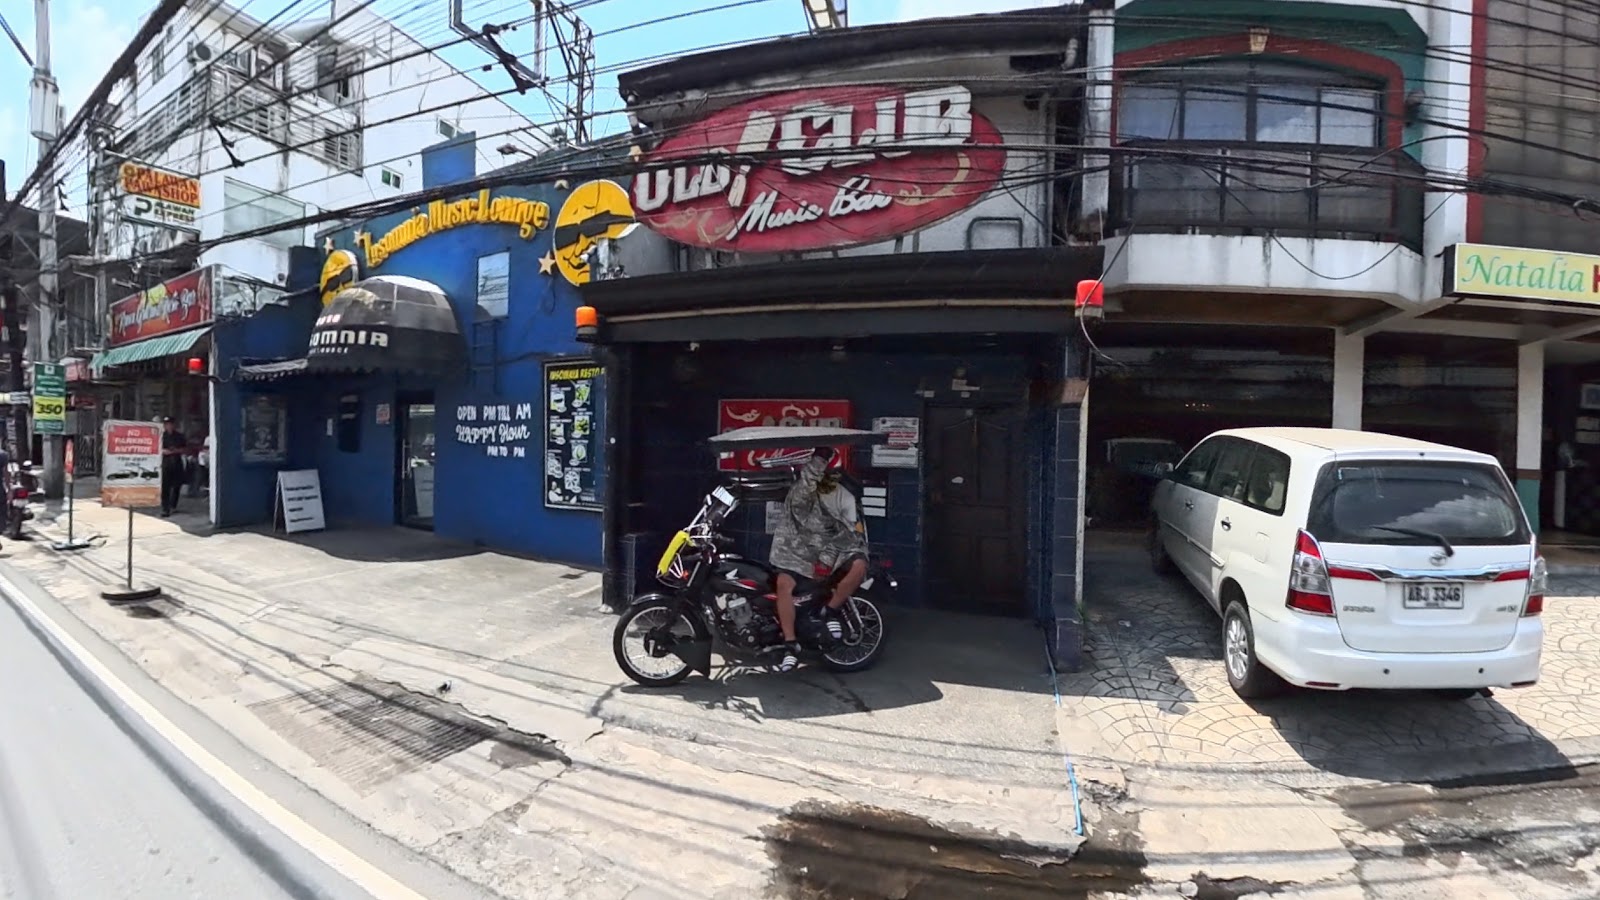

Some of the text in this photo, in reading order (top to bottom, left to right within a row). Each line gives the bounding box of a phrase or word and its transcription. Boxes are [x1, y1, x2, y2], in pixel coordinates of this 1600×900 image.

[776, 84, 973, 176] CLUB
[725, 174, 893, 241] Music Bar
[358, 188, 550, 268] Insomnia Music Lounge
[1461, 254, 1586, 293] Natalia
[457, 405, 477, 421] OPEN
[483, 405, 496, 421] PM
[515, 403, 532, 420] AM
[455, 423, 531, 444] HAPPY Hour
[487, 445, 525, 458] PM TO PM
